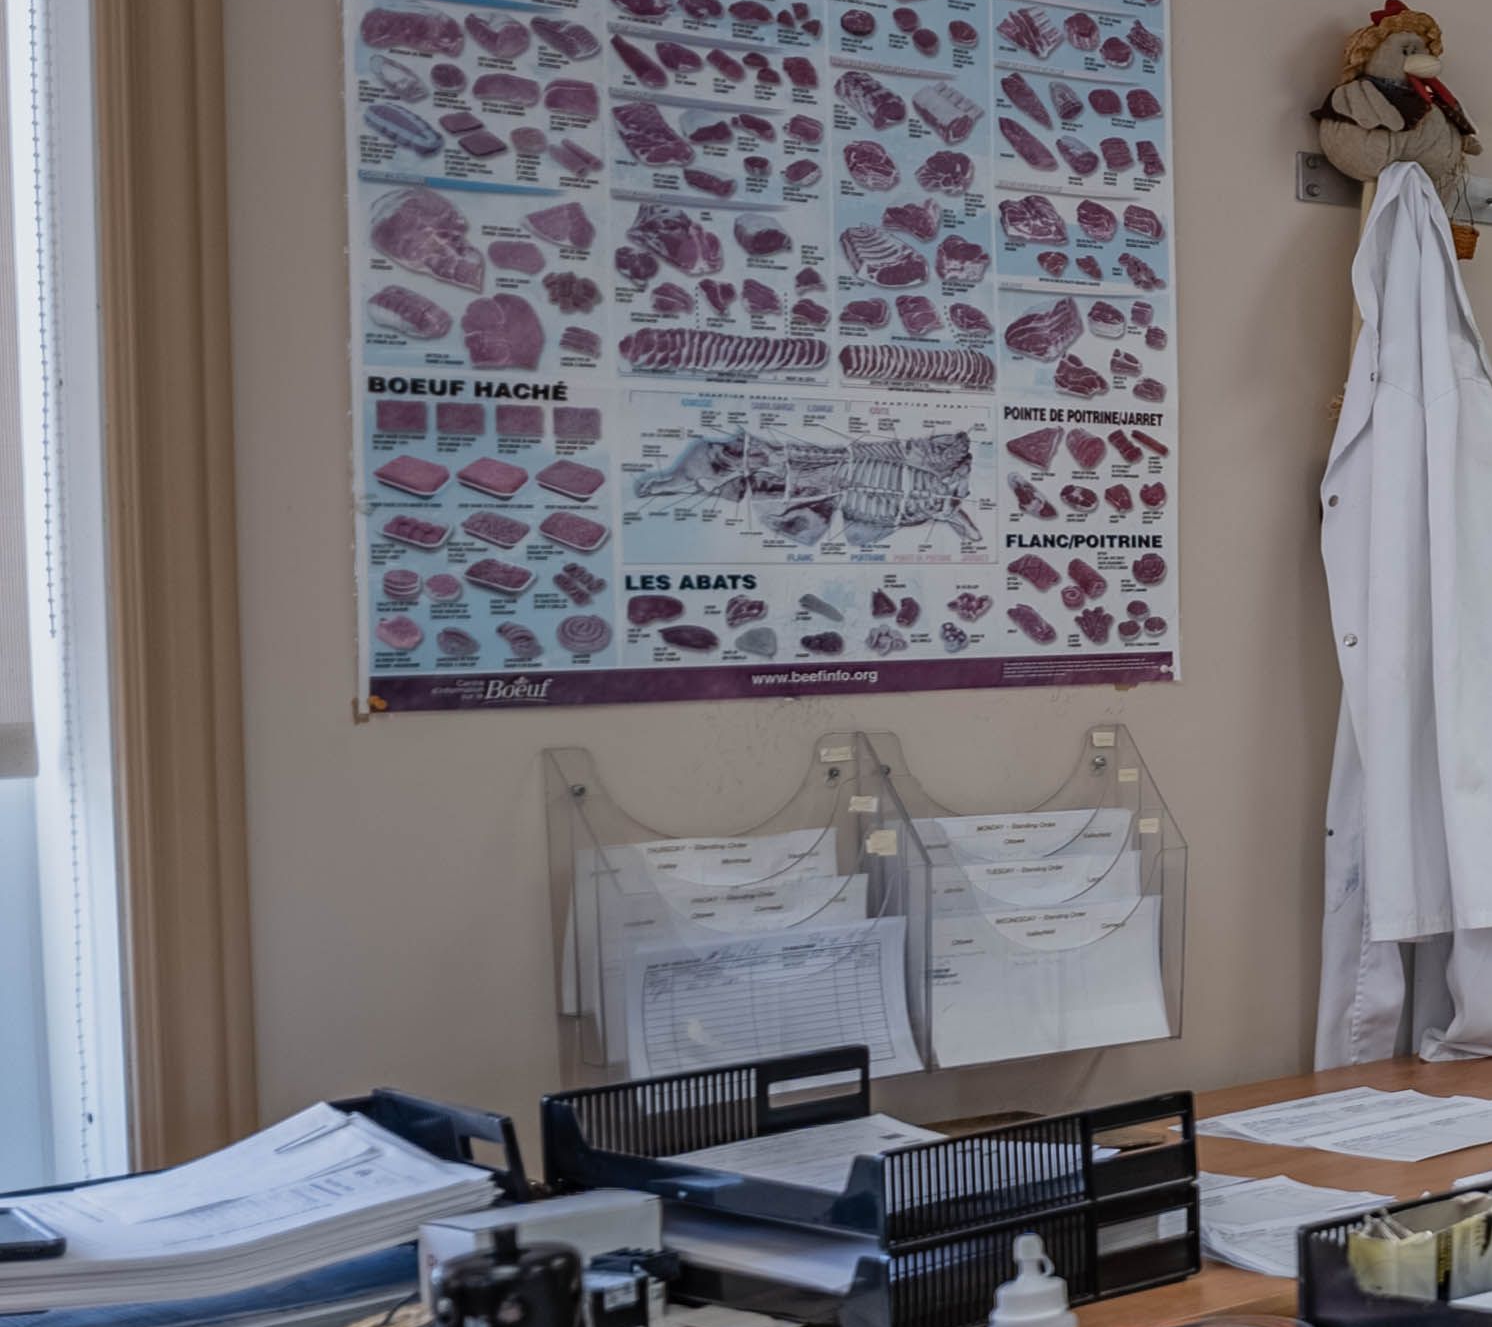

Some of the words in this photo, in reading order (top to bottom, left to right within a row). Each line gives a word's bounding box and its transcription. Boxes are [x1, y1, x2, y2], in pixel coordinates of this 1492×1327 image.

[367, 376, 467, 397] BOEUF
[474, 380, 568, 402] HACHÉ
[1004, 406, 1046, 422] POINTE
[1051, 408, 1064, 422] DE
[1067, 409, 1163, 426] POITRINE/JARRET
[1006, 534, 1163, 549] FLANC/POITRINE
[624, 574, 671, 591] LES
[679, 573, 758, 591] ABATS
[751, 669, 879, 687] www.beefinfo.org
